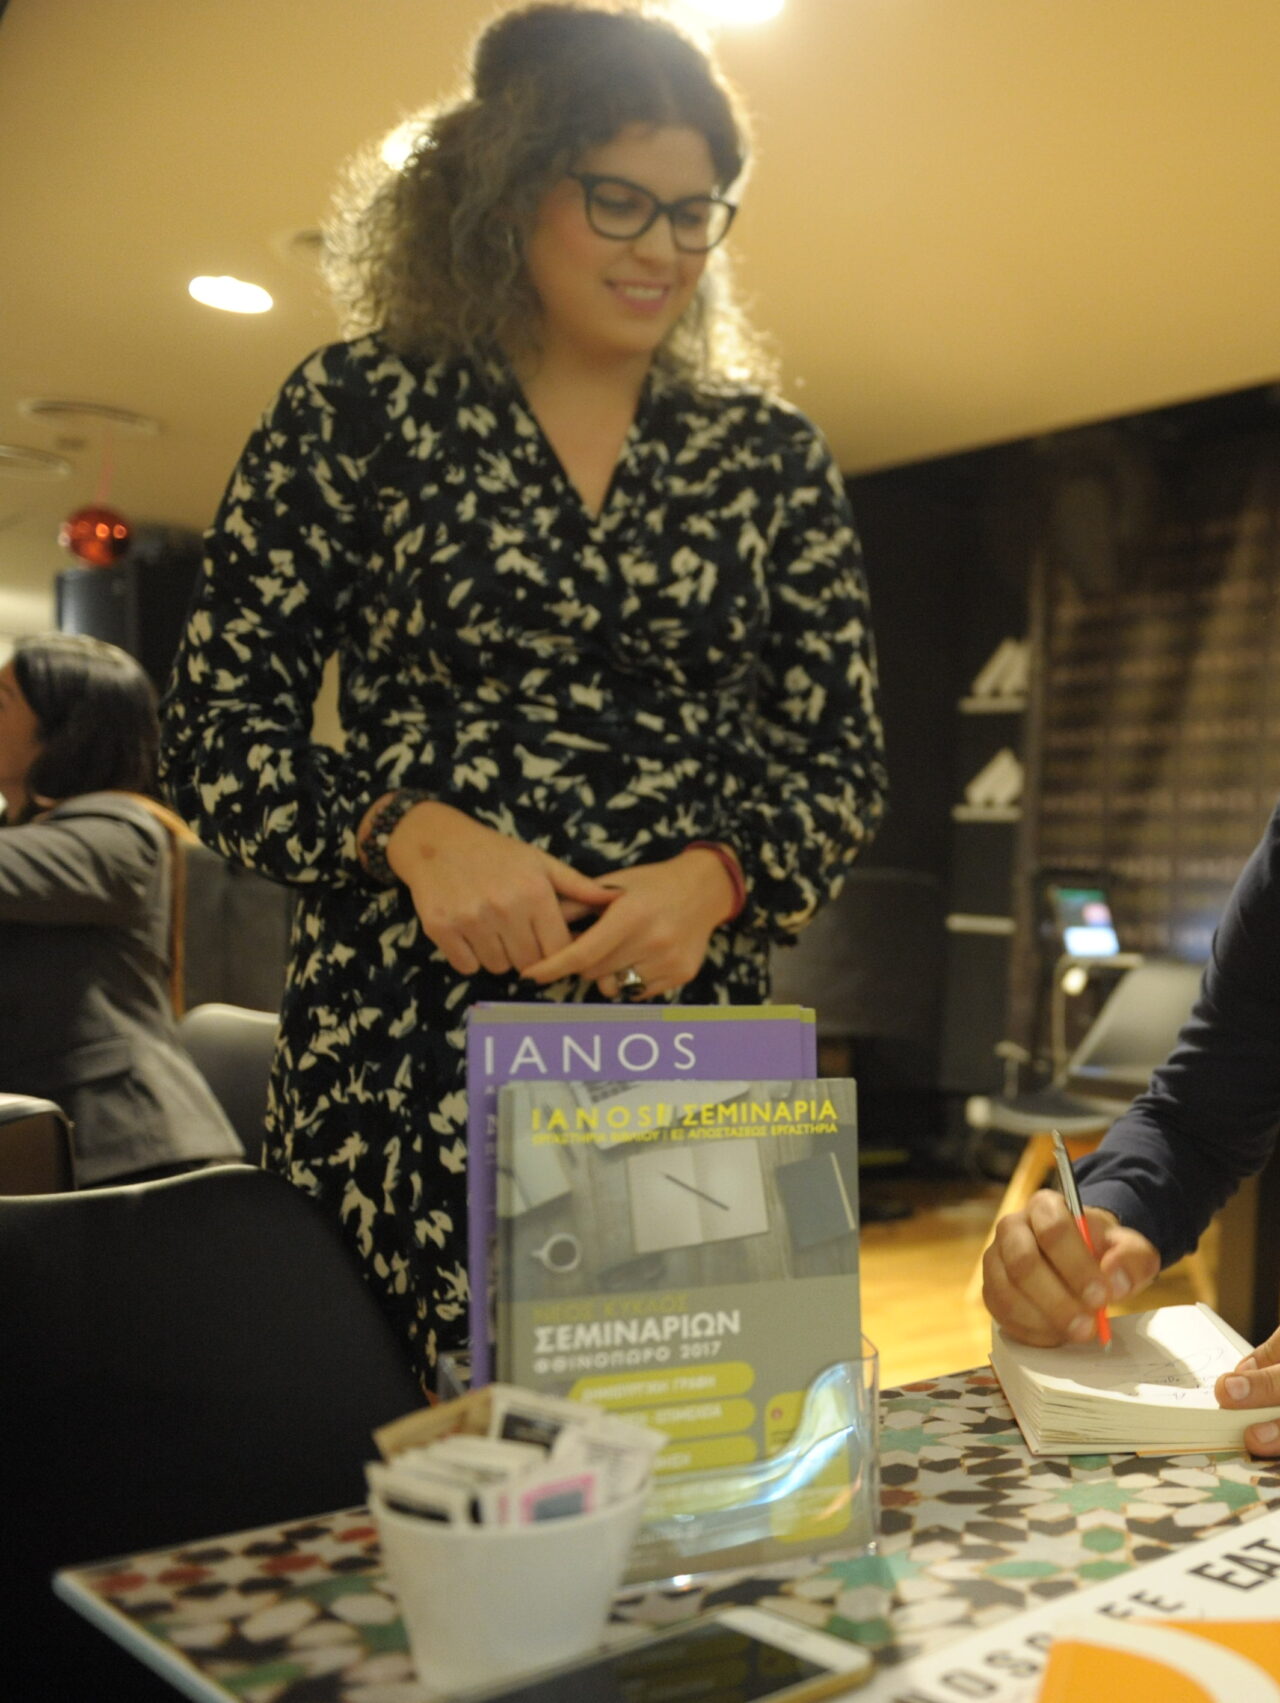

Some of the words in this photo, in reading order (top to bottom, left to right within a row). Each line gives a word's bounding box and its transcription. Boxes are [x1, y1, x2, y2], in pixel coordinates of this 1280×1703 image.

[484, 1031, 697, 1075] IANOS
[531, 1104, 653, 1131] IANOS
[682, 1100, 838, 1127] ΣΕΜΙΝΑΡΙΑ
[533, 1309, 741, 1354] ΣΕΜΙΝΑΡΙΩΝ
[679, 1340, 722, 1360] 2017
